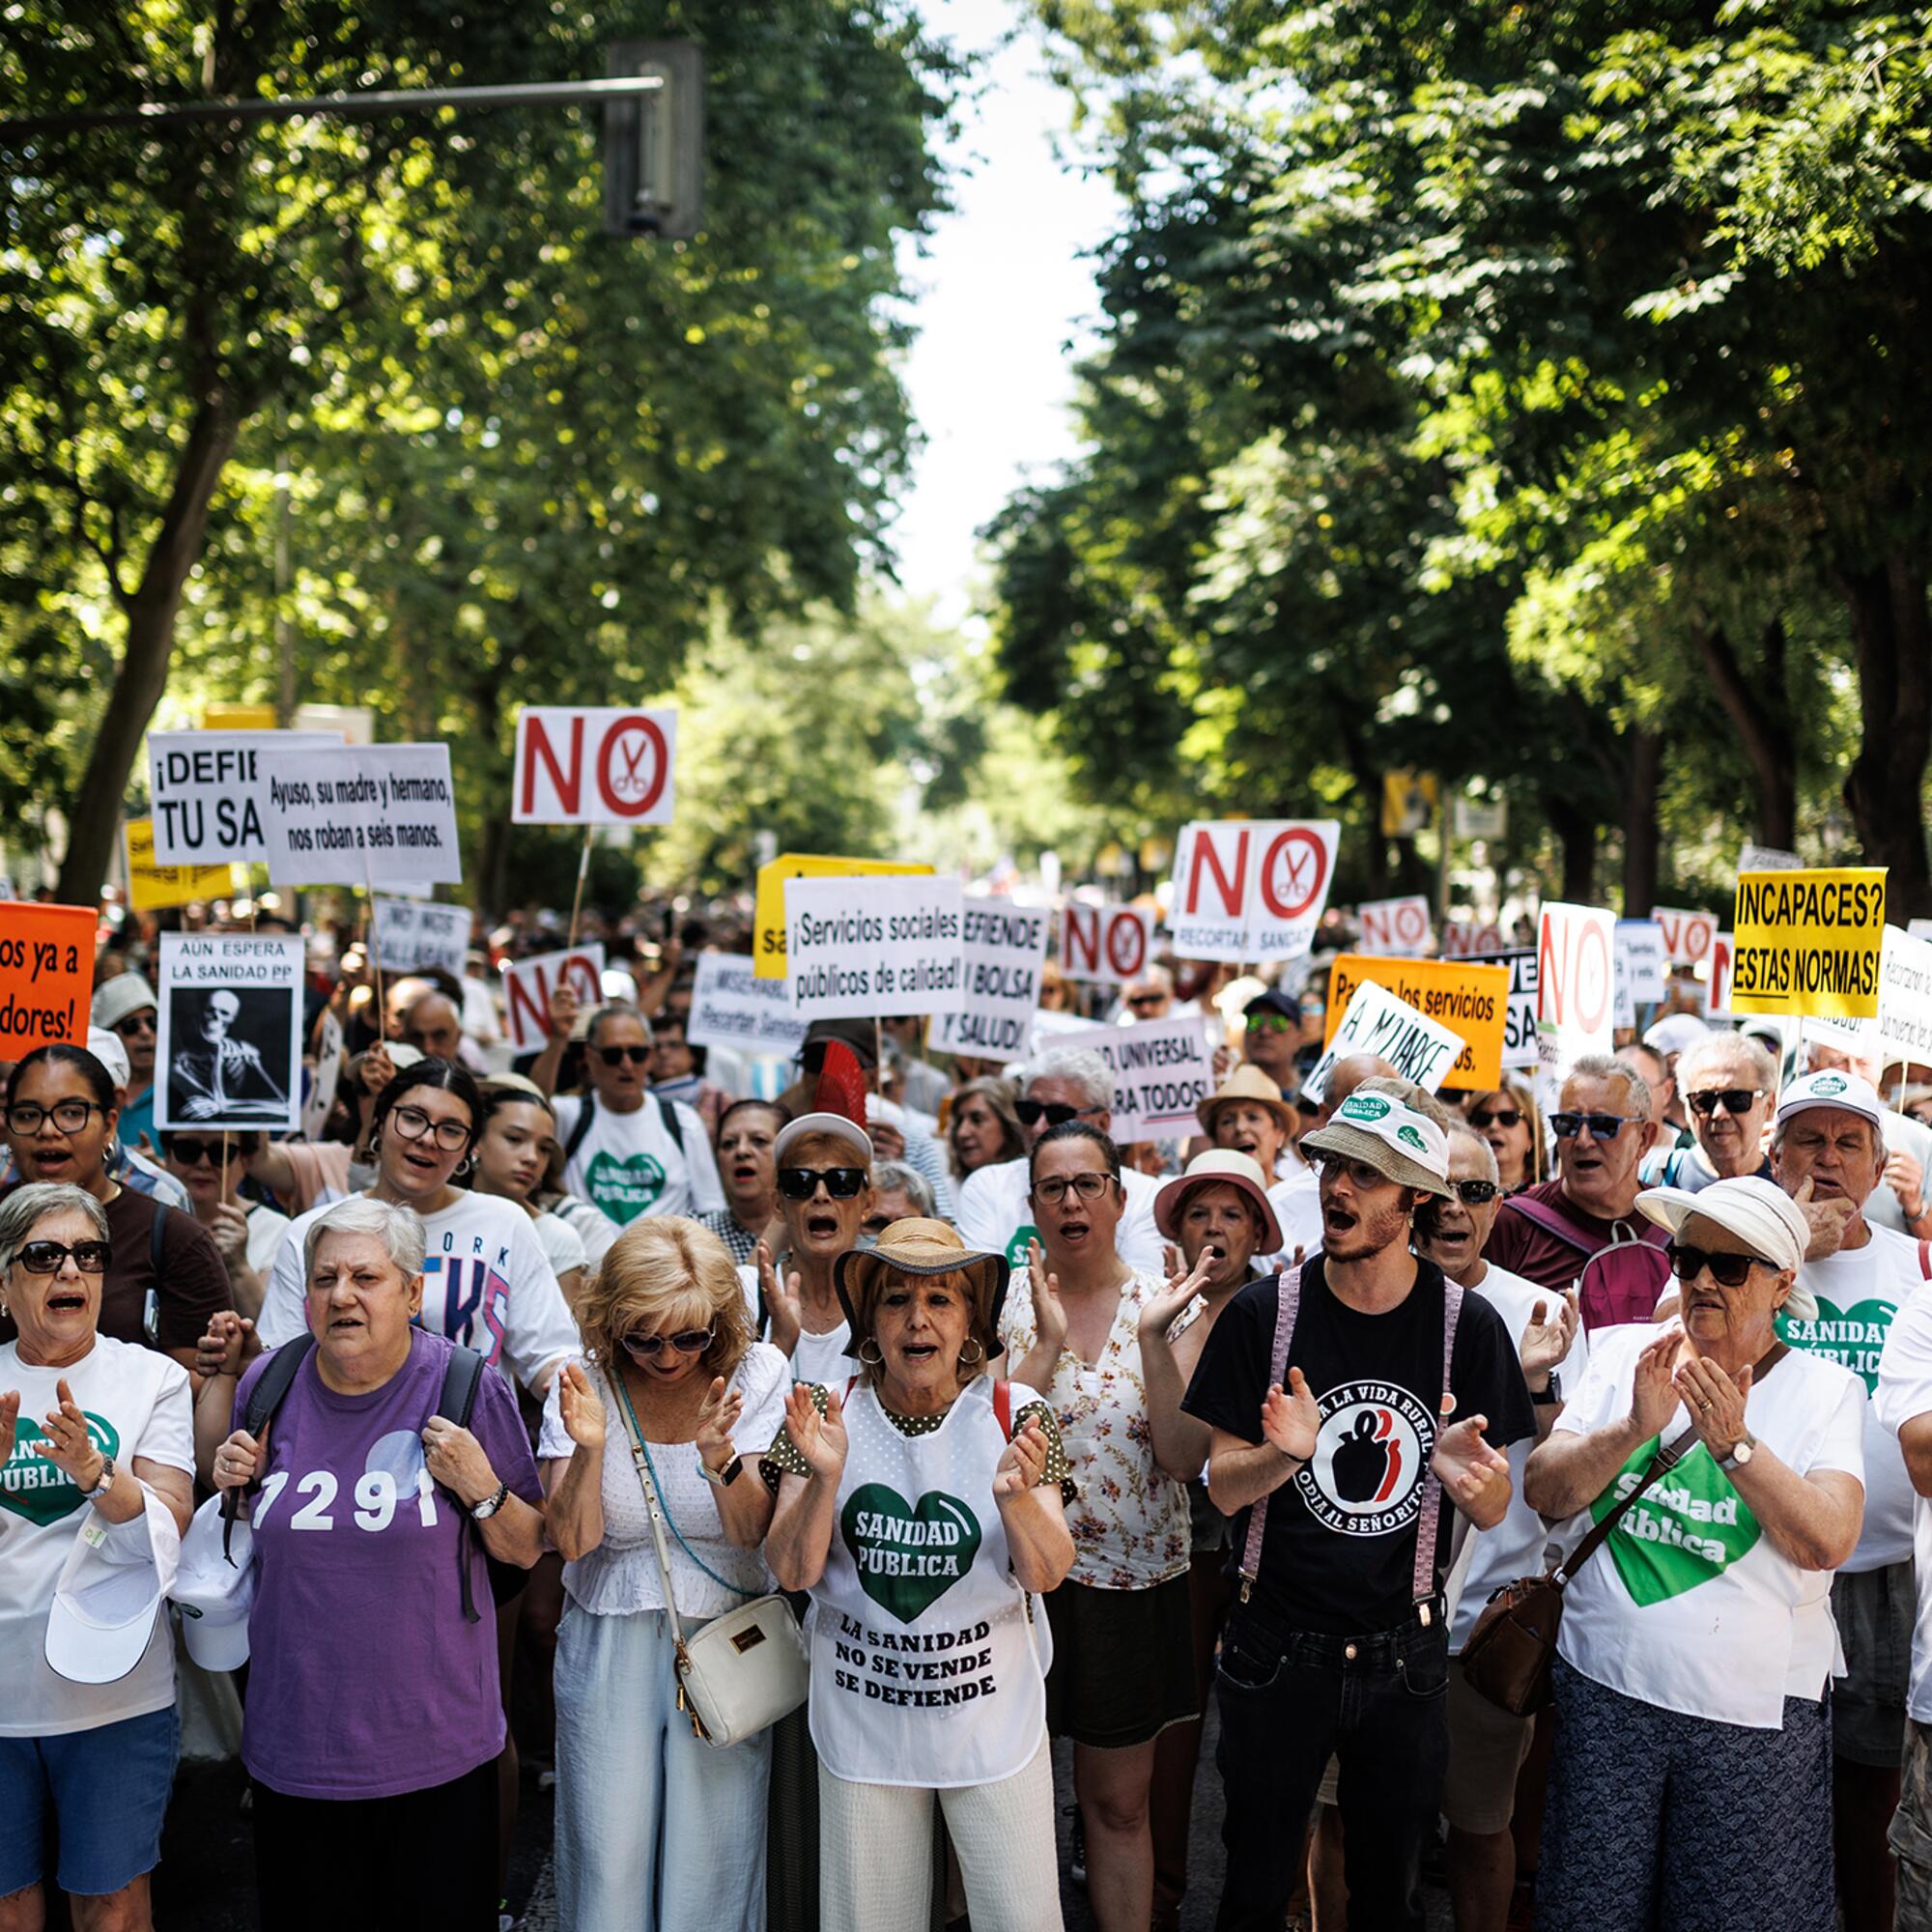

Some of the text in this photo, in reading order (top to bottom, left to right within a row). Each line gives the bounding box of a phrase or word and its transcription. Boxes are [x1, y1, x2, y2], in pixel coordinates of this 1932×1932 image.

[521, 716, 668, 816] NO
[270, 771, 451, 812] Ayuso, su madre y hermano,
[157, 797, 265, 849] TU SA
[288, 818, 442, 851] nos roban a seis manos.
[1185, 827, 1327, 919] NO
[1737, 882, 1884, 927] INCAPACES?
[222, 941, 285, 957] ESPERA
[793, 906, 958, 956] ¡Servicios sociales
[1064, 904, 1147, 977] NO
[1362, 907, 1427, 951] NO
[33, 941, 58, 983] ya
[66, 945, 78, 974] a
[172, 964, 293, 981] LA SANIDAD PP
[796, 963, 869, 1009] públicos
[874, 960, 895, 994] de
[899, 956, 960, 992] calidad!
[1537, 912, 1608, 1035] NO
[1733, 947, 1881, 996] ESTAS NORMAS!
[0, 992, 74, 1039] dores!
[1343, 998, 1368, 1042] A
[1425, 983, 1494, 1021] servicios
[1330, 1389, 1354, 1409] LA
[1356, 1385, 1399, 1406] VIDA
[1399, 1400, 1435, 1453] RURAL
[0, 1462, 77, 1492] ÚBLI
[1298, 1470, 1328, 1510] ODIA
[1324, 1509, 1344, 1529] AL
[855, 1510, 960, 1547] SANIDAD
[858, 1540, 960, 1577] PÚBLICA
[839, 1613, 990, 1653] LA SANIDAD
[836, 1641, 992, 1681] NO SE VENDE
[836, 1669, 997, 1708] SE DEFIENDE
